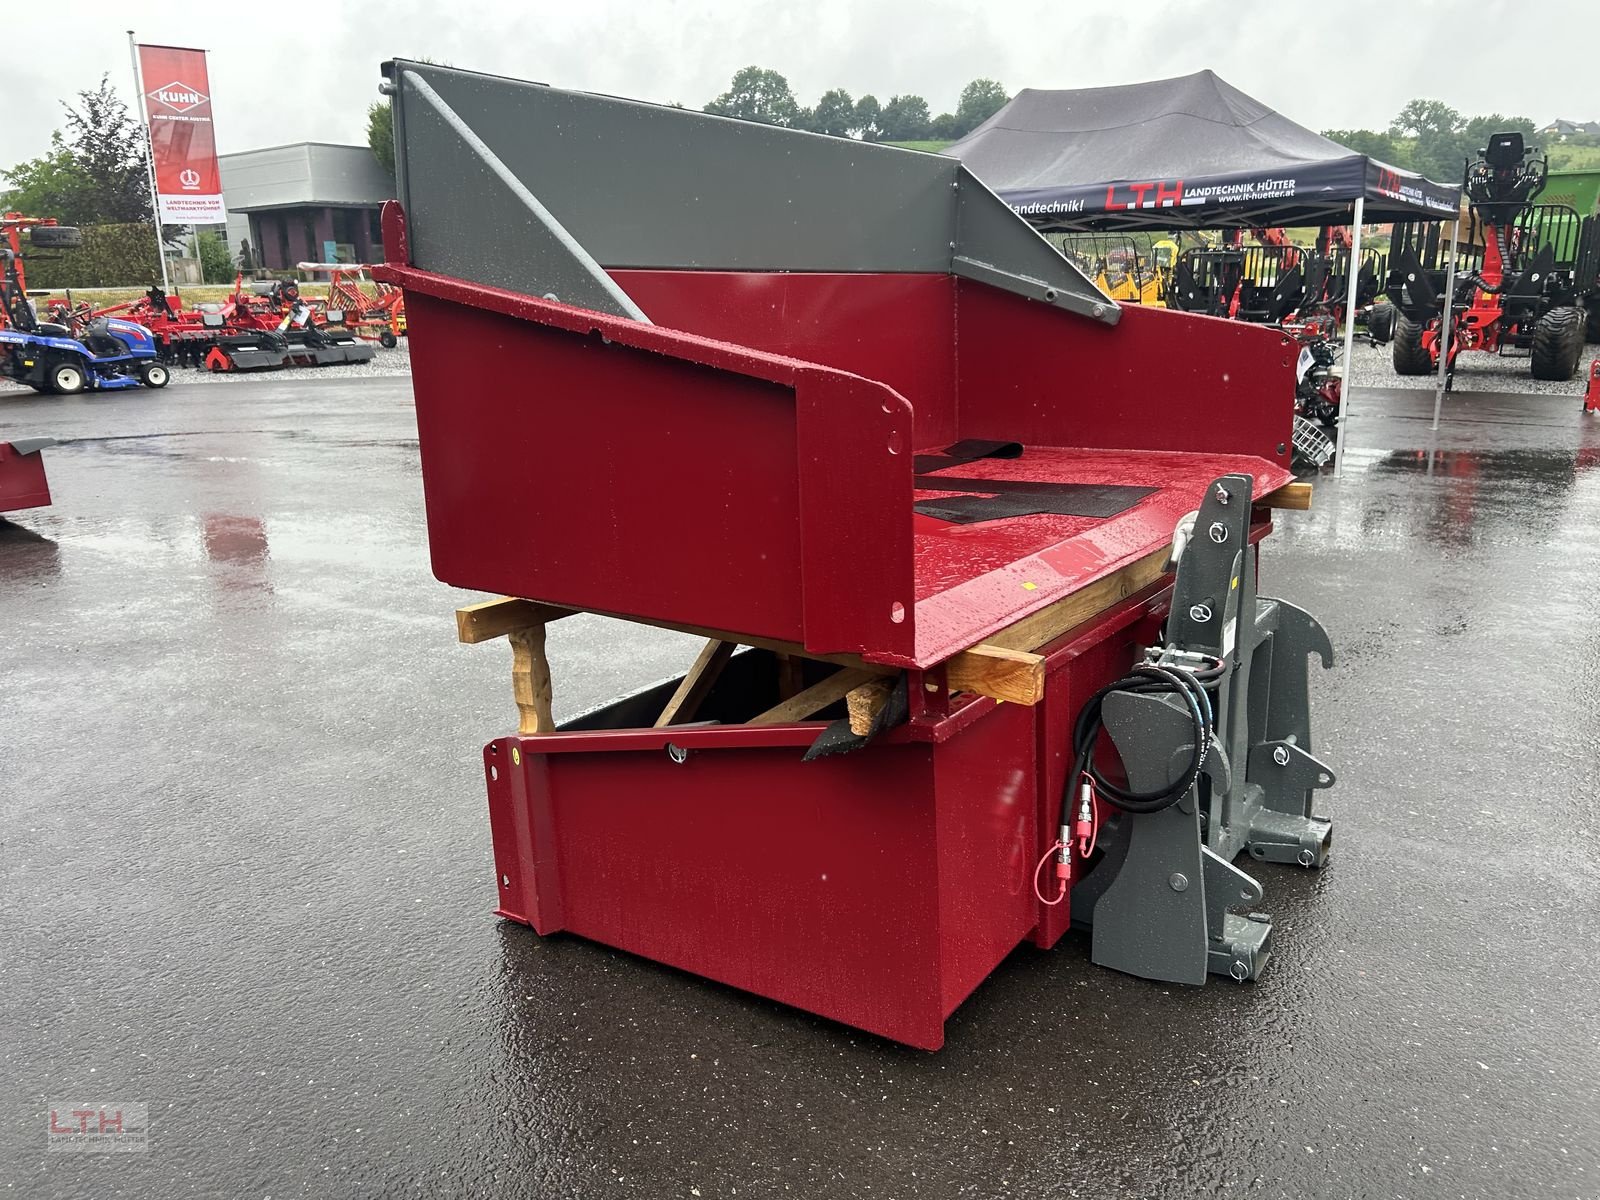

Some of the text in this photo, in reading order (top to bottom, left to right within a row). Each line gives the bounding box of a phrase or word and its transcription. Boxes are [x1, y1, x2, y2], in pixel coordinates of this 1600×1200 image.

[158, 91, 199, 105] KUHN
[1104, 180, 1184, 211] LTH
[1184, 178, 1296, 198] LANDTECHNIK HÜTTER
[1218, 188, 1295, 203] www.lt-huetter.at
[1009, 199, 1085, 215] andtechnik!
